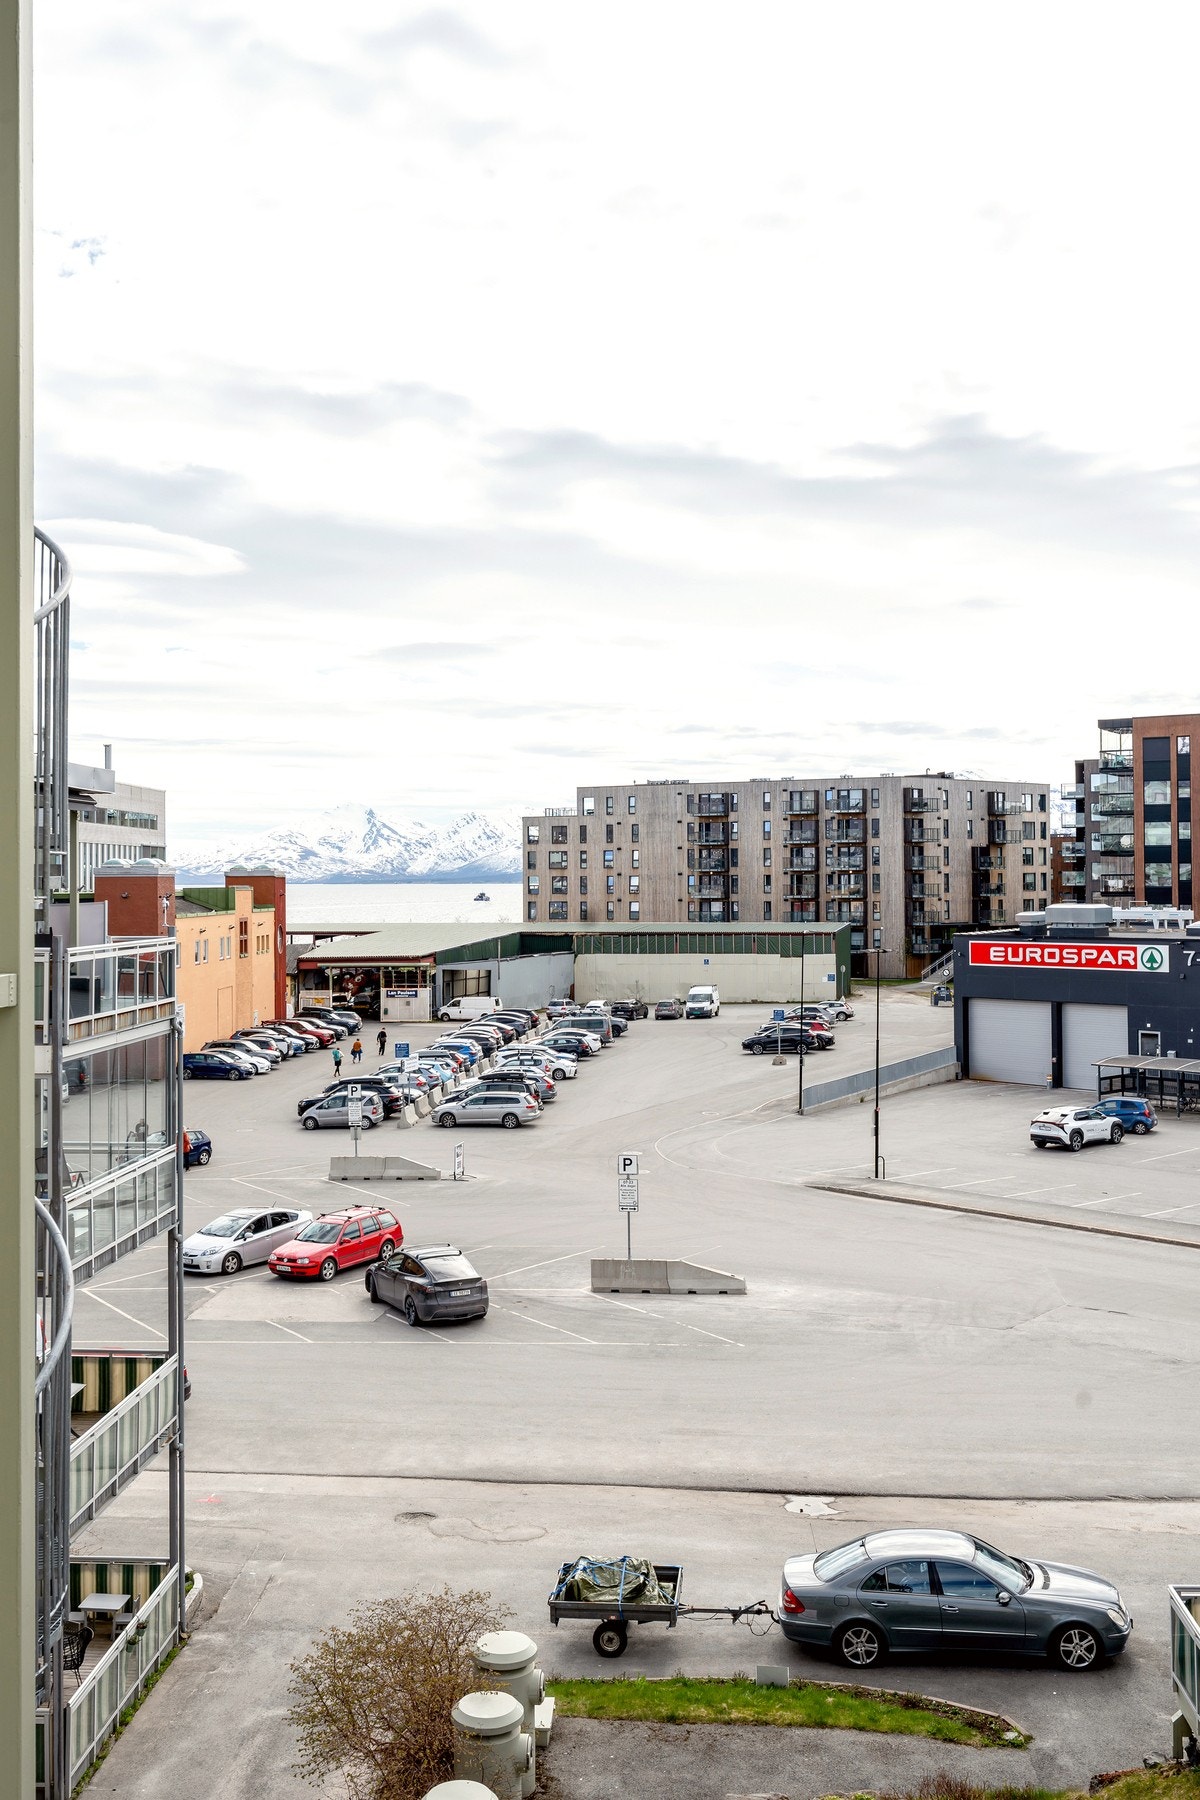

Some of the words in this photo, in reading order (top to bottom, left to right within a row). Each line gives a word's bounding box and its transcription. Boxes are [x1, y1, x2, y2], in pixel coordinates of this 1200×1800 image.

[989, 946, 1136, 966] EUROSPAR
[350, 1085, 358, 1096] P
[623, 1158, 632, 1171] P
